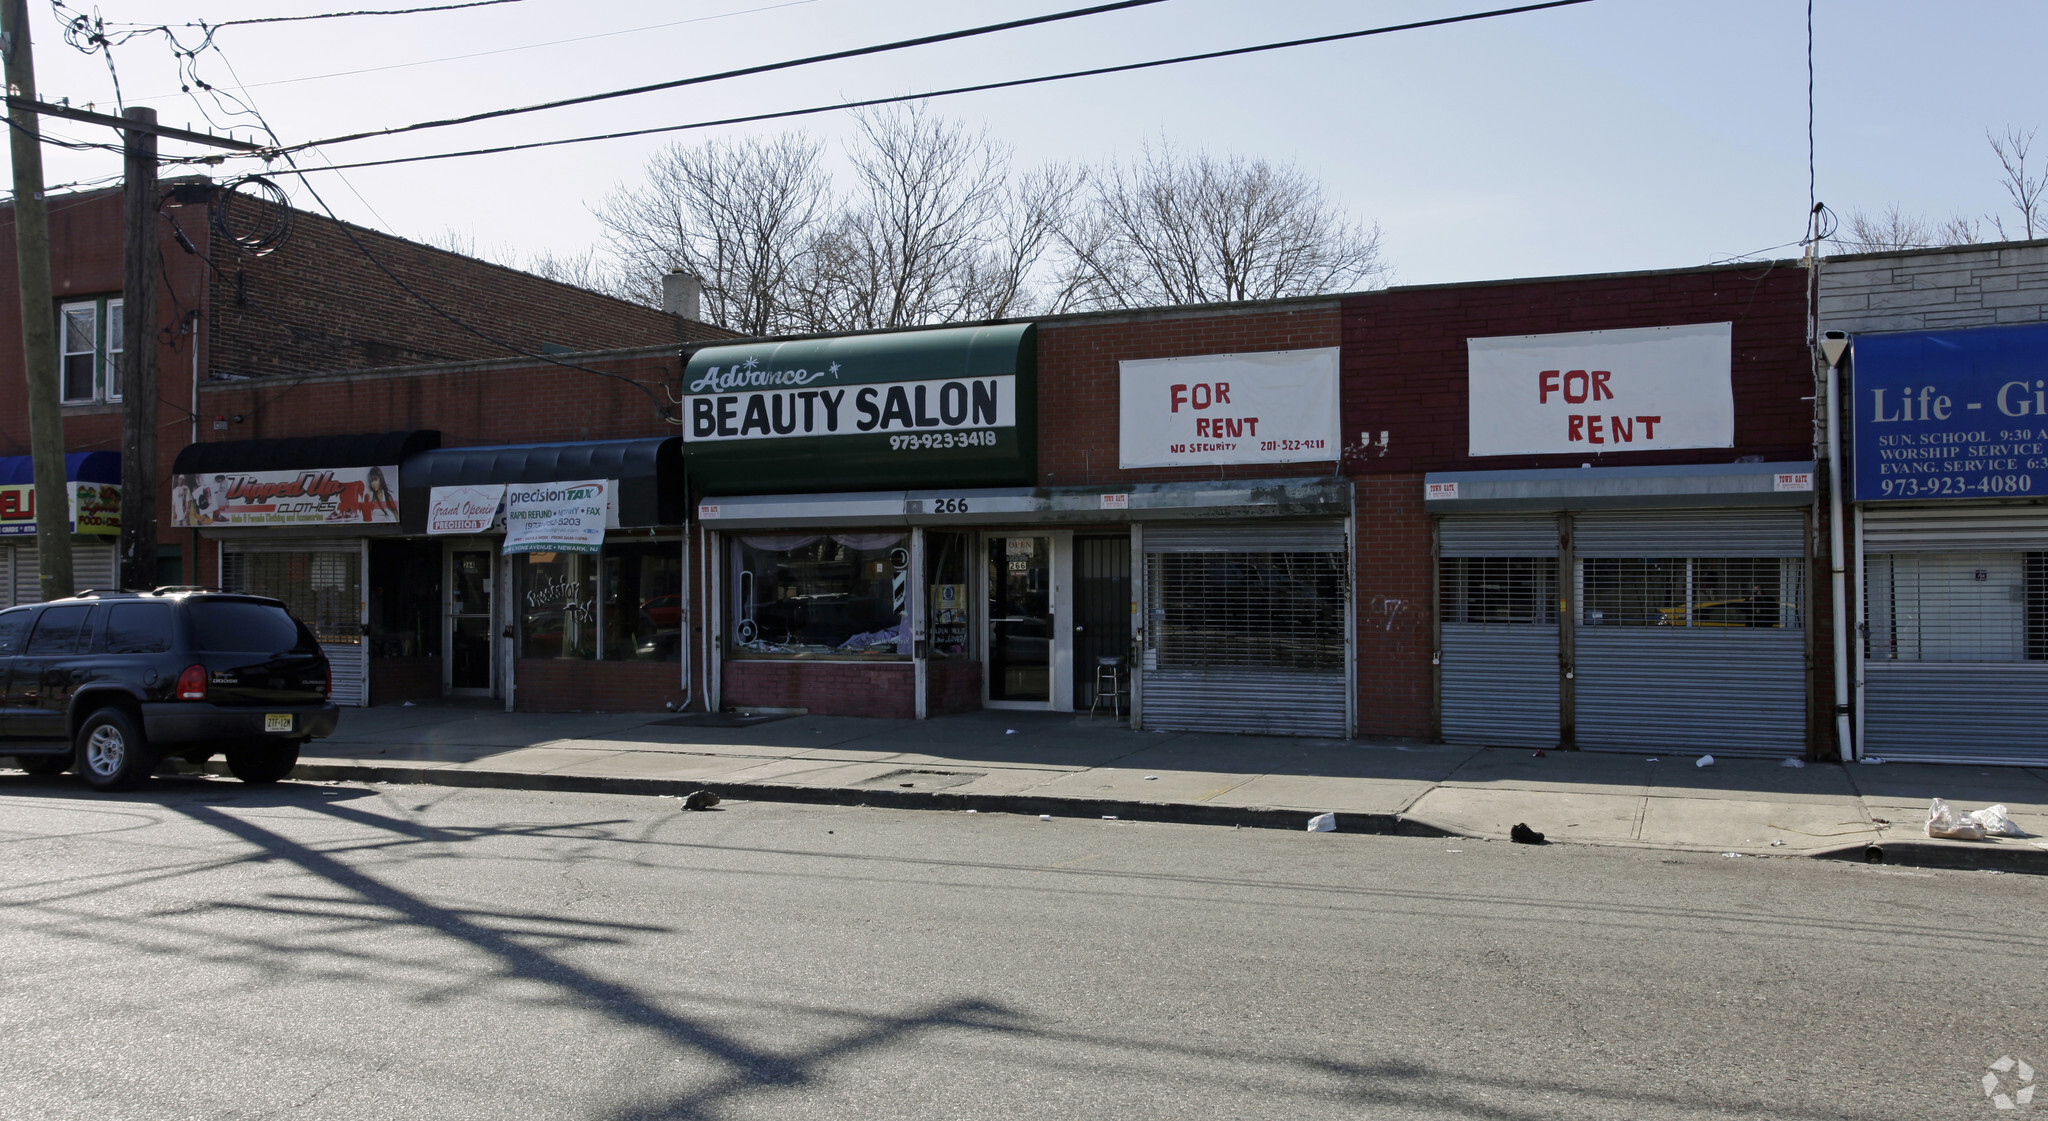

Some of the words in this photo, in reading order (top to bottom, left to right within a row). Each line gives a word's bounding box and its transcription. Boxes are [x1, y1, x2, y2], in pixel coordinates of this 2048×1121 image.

[690, 365, 824, 393] Advance
[1538, 369, 1614, 404] FOR
[1170, 382, 1231, 413] FOR
[1870, 385, 1952, 423] Life
[693, 389, 845, 438] BEAUTY
[856, 380, 998, 432] SALON
[1196, 417, 1259, 439] RENT
[1567, 414, 1661, 445] RENT
[889, 431, 997, 450] 973-923-3418
[1879, 434, 1916, 447] SUN.
[1919, 431, 1991, 445] SCHOOL
[2000, 429, 2031, 441] 9:30
[1170, 444, 1186, 454] NO
[1880, 447, 1960, 460] WORSHIP
[1968, 443, 2044, 457] SERVICE
[1880, 461, 1940, 475] EVANG.
[1943, 458, 2018, 472] SERVICE
[226, 472, 305, 504] Dipped
[297, 471, 346, 501] Up
[1881, 474, 2031, 496] 973-923-4080
[277, 501, 337, 513] CLOTHES
[433, 502, 460, 521] Grand
[462, 501, 496, 518] Openin
[510, 511, 527, 520] RAPID
[528, 510, 552, 519] REFUND
[586, 507, 601, 516] FAX
[934, 499, 969, 514] 266
[79, 515, 102, 525] FOOD
[435, 520, 477, 529] PRECISION
[1010, 562, 1025, 570] 266
